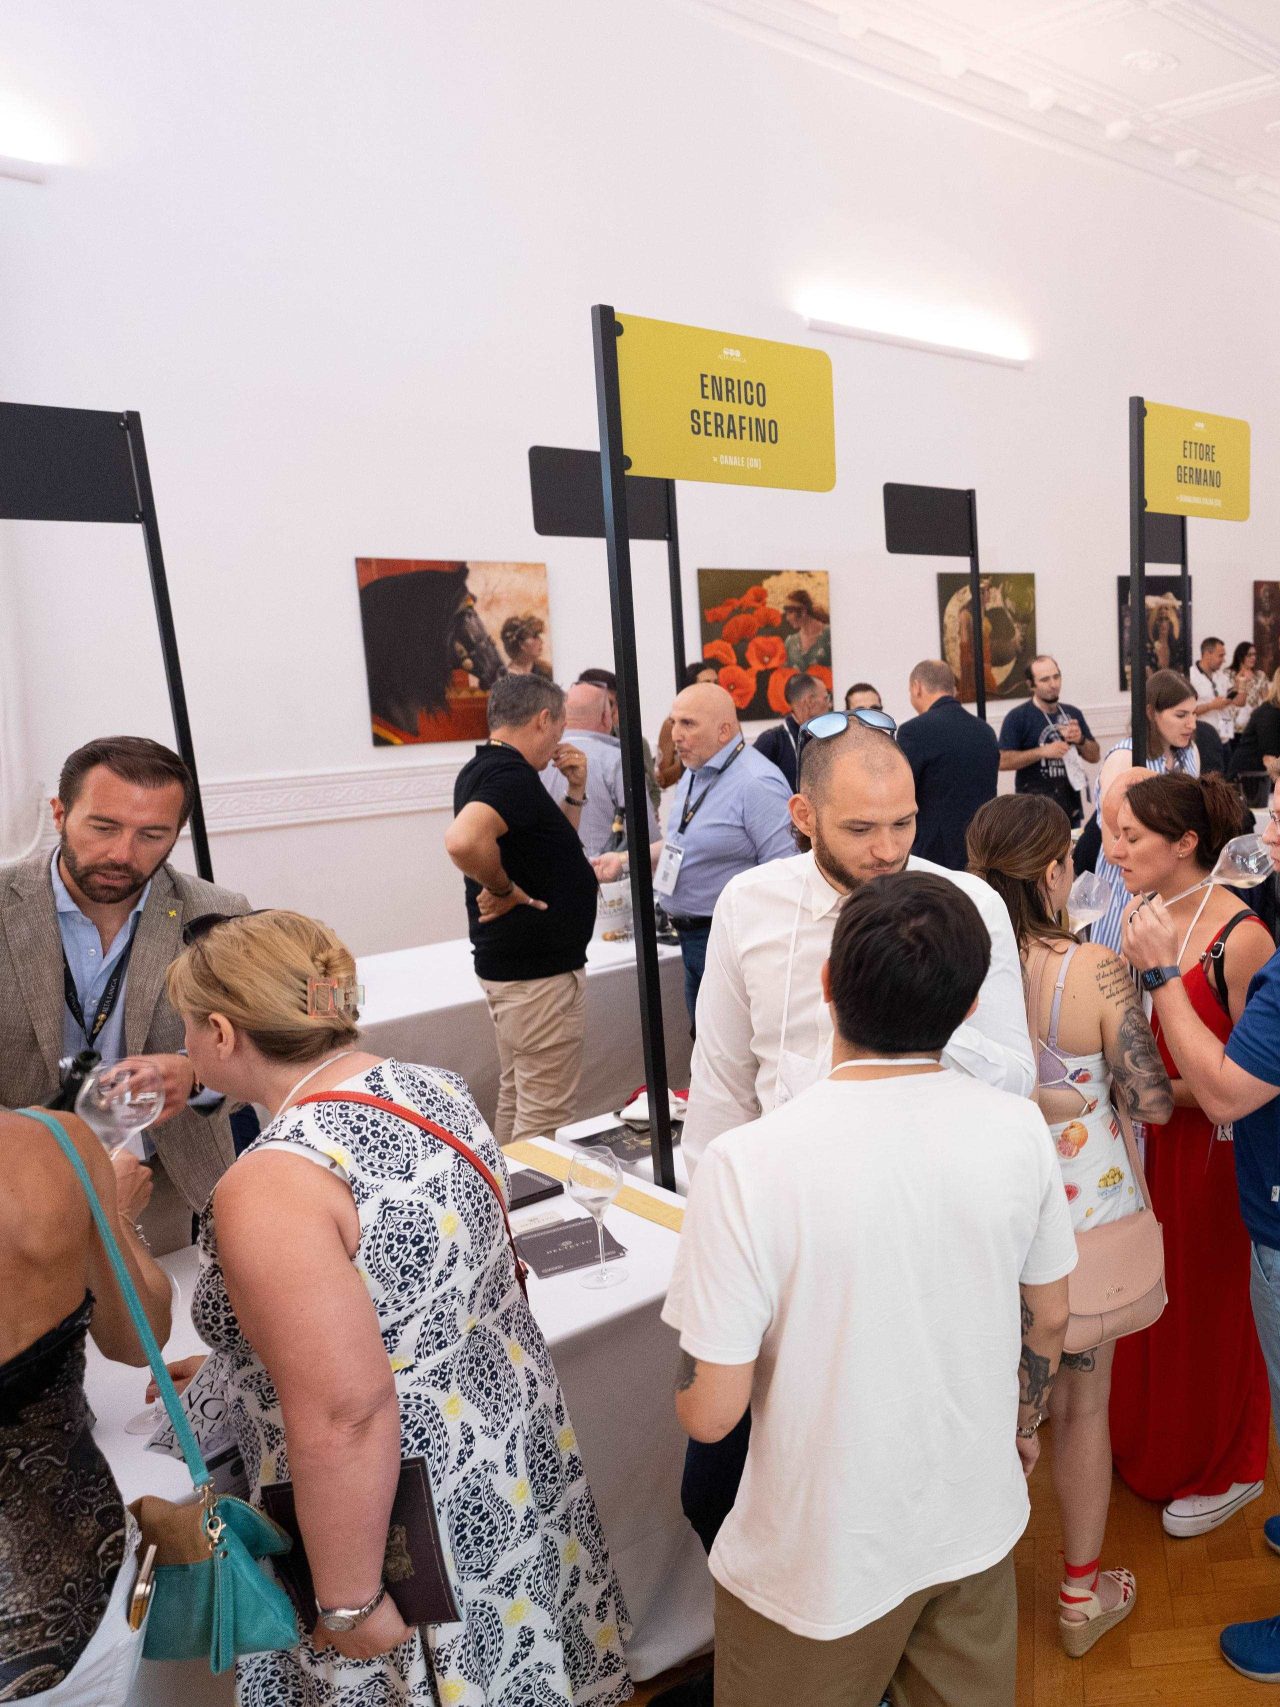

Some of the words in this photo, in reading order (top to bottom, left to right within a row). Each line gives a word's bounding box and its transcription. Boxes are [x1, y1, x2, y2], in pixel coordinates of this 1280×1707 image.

[700, 373, 767, 408] ENRICO
[690, 409, 779, 445] SERAFINO
[1183, 440, 1216, 463] ETTORE
[1176, 465, 1222, 488] GERMANO
